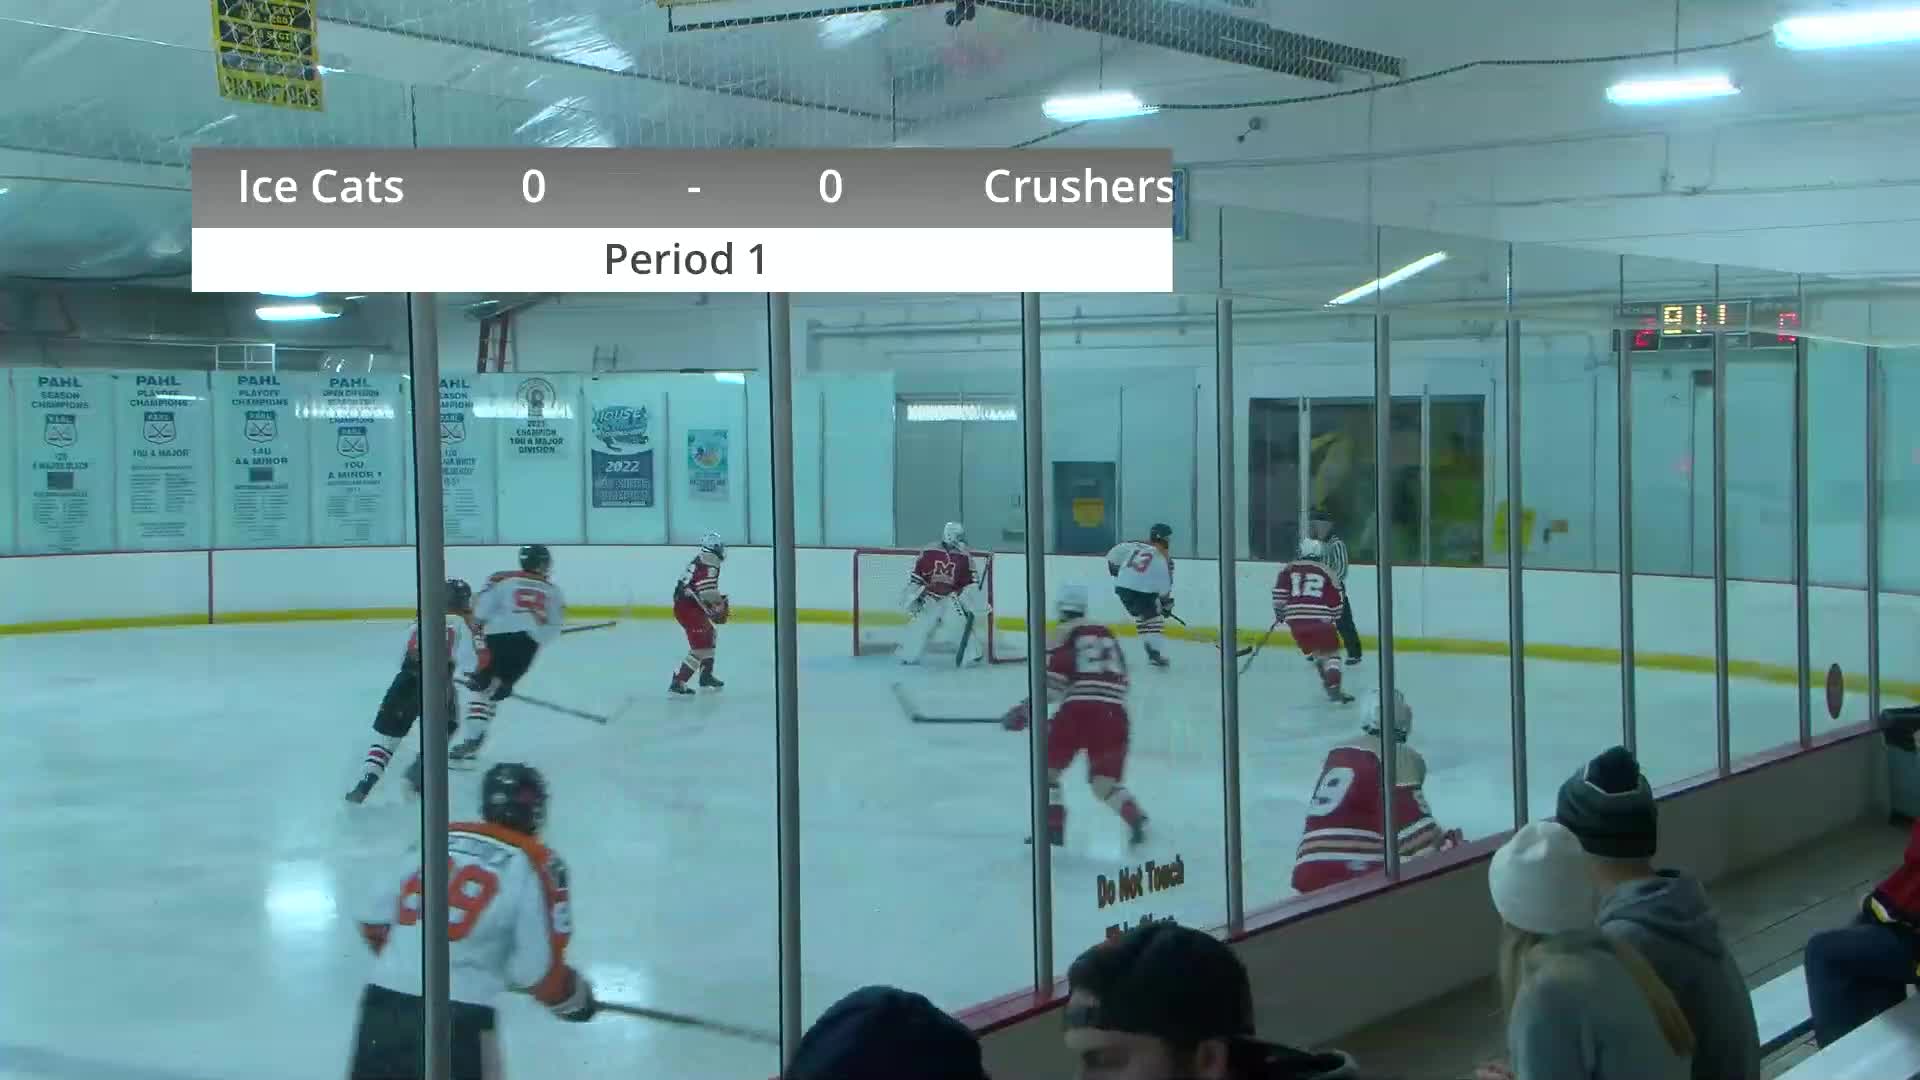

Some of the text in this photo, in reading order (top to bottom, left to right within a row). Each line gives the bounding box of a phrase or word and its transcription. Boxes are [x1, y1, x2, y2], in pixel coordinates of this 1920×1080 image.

[39, 376, 82, 387] PAHL
[136, 376, 182, 386] PAHL
[238, 376, 280, 386] PAHL
[330, 378, 369, 388] PAHL
[440, 379, 470, 389] AHL
[159, 449, 189, 457] MAJOR
[519, 446, 555, 454] DIVISION
[605, 460, 640, 472] 2022
[933, 560, 956, 579] M
[1290, 572, 1325, 598] 12
[1096, 853, 1185, 909] Do Not Touch
